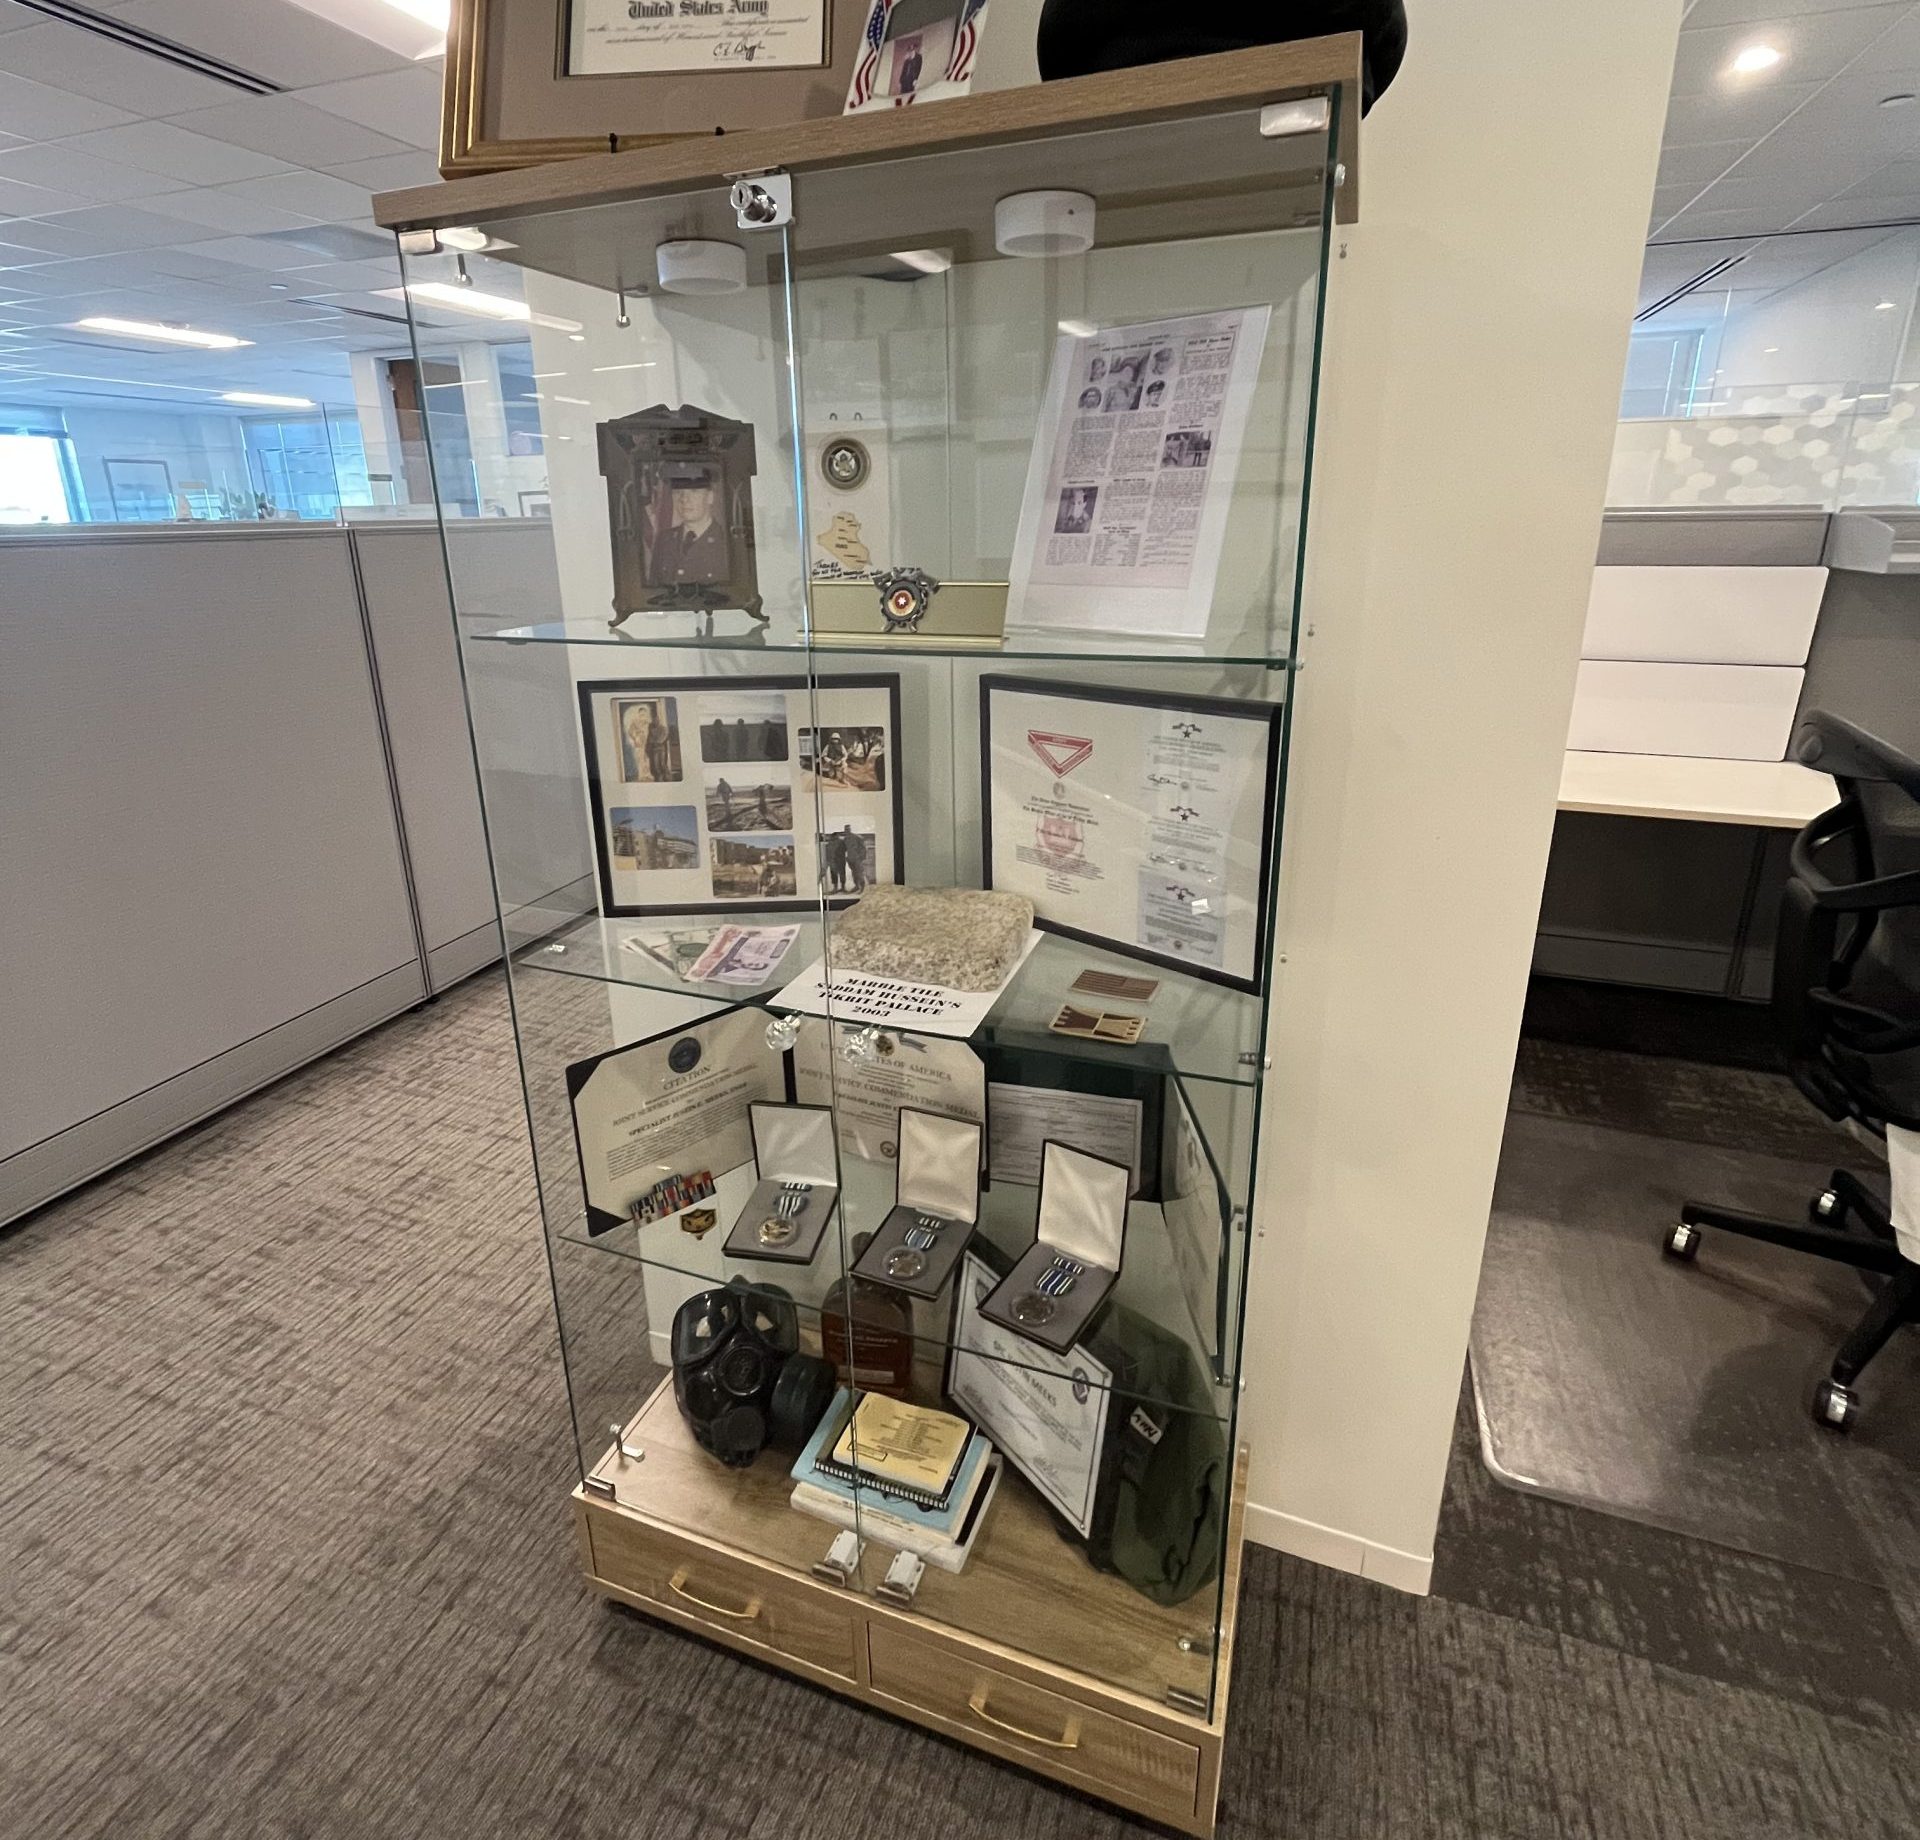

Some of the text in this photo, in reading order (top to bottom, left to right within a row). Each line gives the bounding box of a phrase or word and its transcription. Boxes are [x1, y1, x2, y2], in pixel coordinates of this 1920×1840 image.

[628, 0, 769, 19] United States Army
[815, 982, 962, 1009] SADDAM HUSSEIN'S
[847, 978, 945, 998] MARBLE TILE
[852, 1005, 893, 1018] 2003
[875, 1000, 945, 1016] PALLACE
[663, 1065, 712, 1091] CITATION
[910, 1063, 952, 1081] AMERICA
[864, 1084, 942, 1108] COMMENDATION
[945, 1102, 980, 1119] MEDAL
[1031, 1378, 1057, 1408] MEEKS
